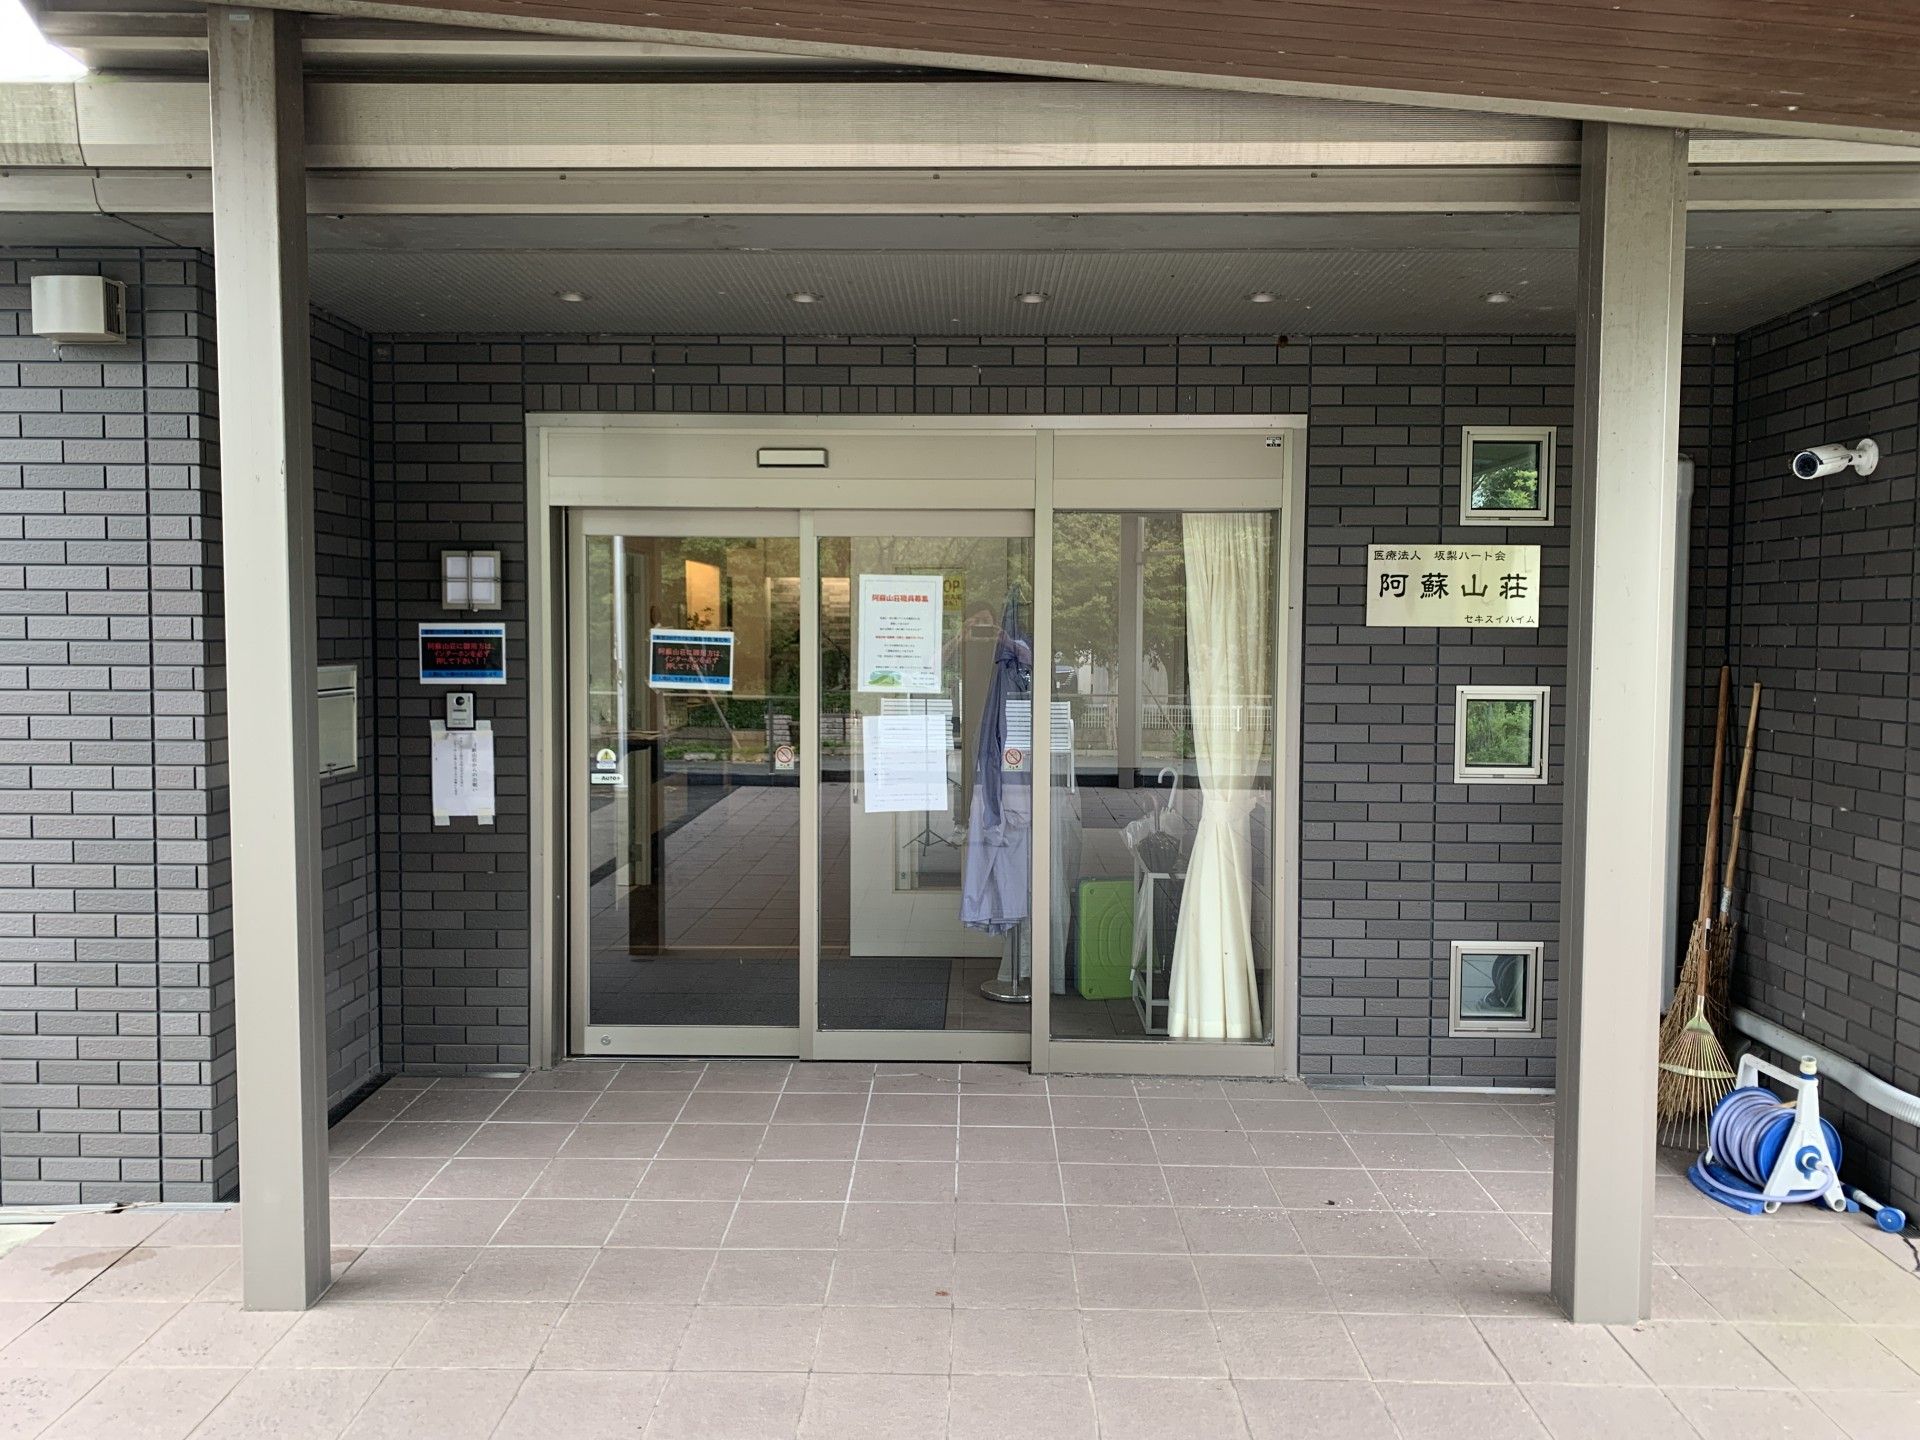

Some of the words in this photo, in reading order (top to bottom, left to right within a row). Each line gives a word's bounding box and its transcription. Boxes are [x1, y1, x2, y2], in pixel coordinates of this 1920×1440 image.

[1373, 550, 1422, 561] 医療法人
[1434, 550, 1507, 562] 坂梨ハート会
[1379, 572, 1529, 600] 阿蘇山荘
[1464, 614, 1536, 624] セキスイハイム
